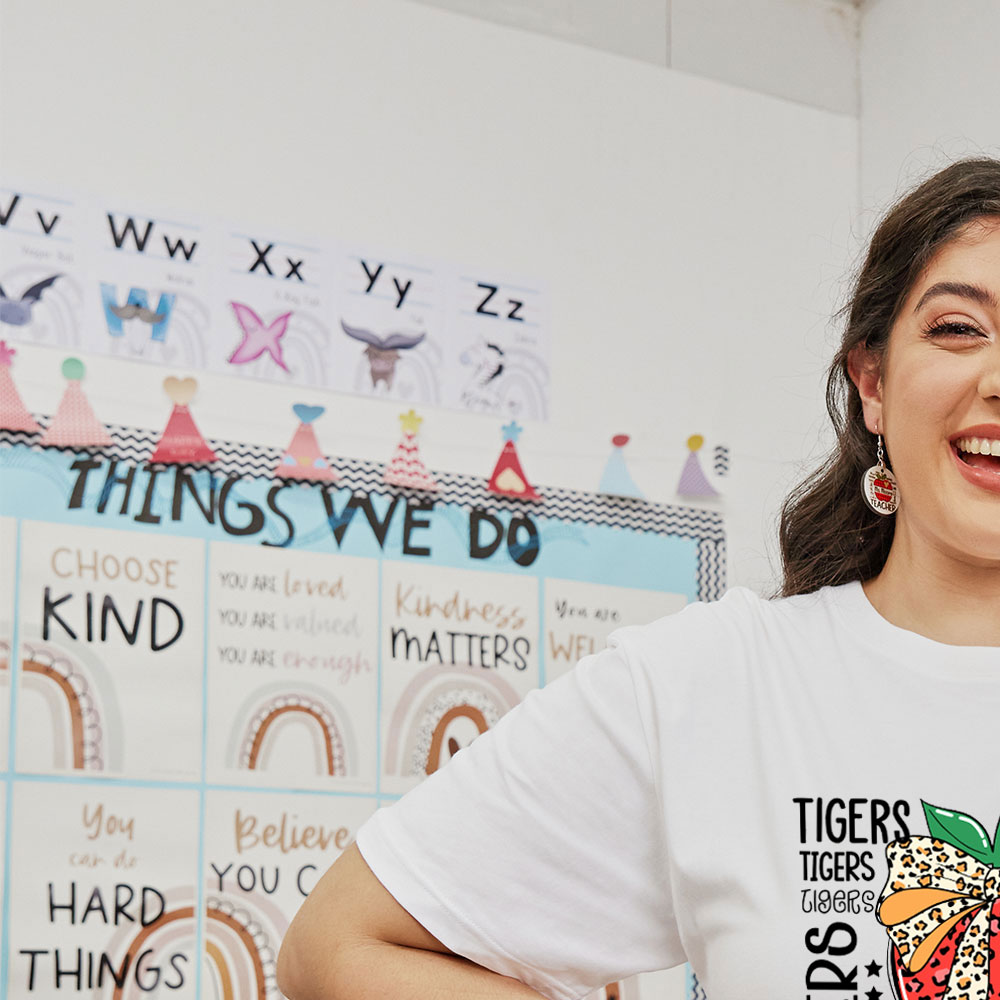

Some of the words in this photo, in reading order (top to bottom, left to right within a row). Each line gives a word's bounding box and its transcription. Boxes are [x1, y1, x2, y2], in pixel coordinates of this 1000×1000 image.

[68, 459, 295, 547] THINGS
[321, 487, 435, 557] WE
[469, 508, 541, 567] DO
[871, 499, 897, 512] TEACHER
[51, 547, 179, 589] CHOOSE
[218, 572, 248, 590] YOU
[252, 574, 277, 593] ARE
[284, 569, 347, 601] loved
[42, 586, 184, 651] KIND
[218, 608, 248, 626] YOU
[251, 611, 277, 630] ARE
[283, 607, 363, 639] valued
[395, 581, 527, 630] Kindness
[217, 645, 248, 664] YOU
[251, 648, 276, 667] ARE
[282, 650, 373, 685] enough
[391, 626, 531, 671] MATTERS
[83, 803, 135, 840] You
[234, 808, 350, 854] Believe
[792, 797, 910, 845] TIGERS
[69, 852, 104, 868] can
[113, 849, 138, 869] do
[211, 863, 279, 894] YOU
[800, 851, 876, 881] TIGERS
[48, 881, 166, 927] HARD
[19, 947, 188, 992] THINGS
